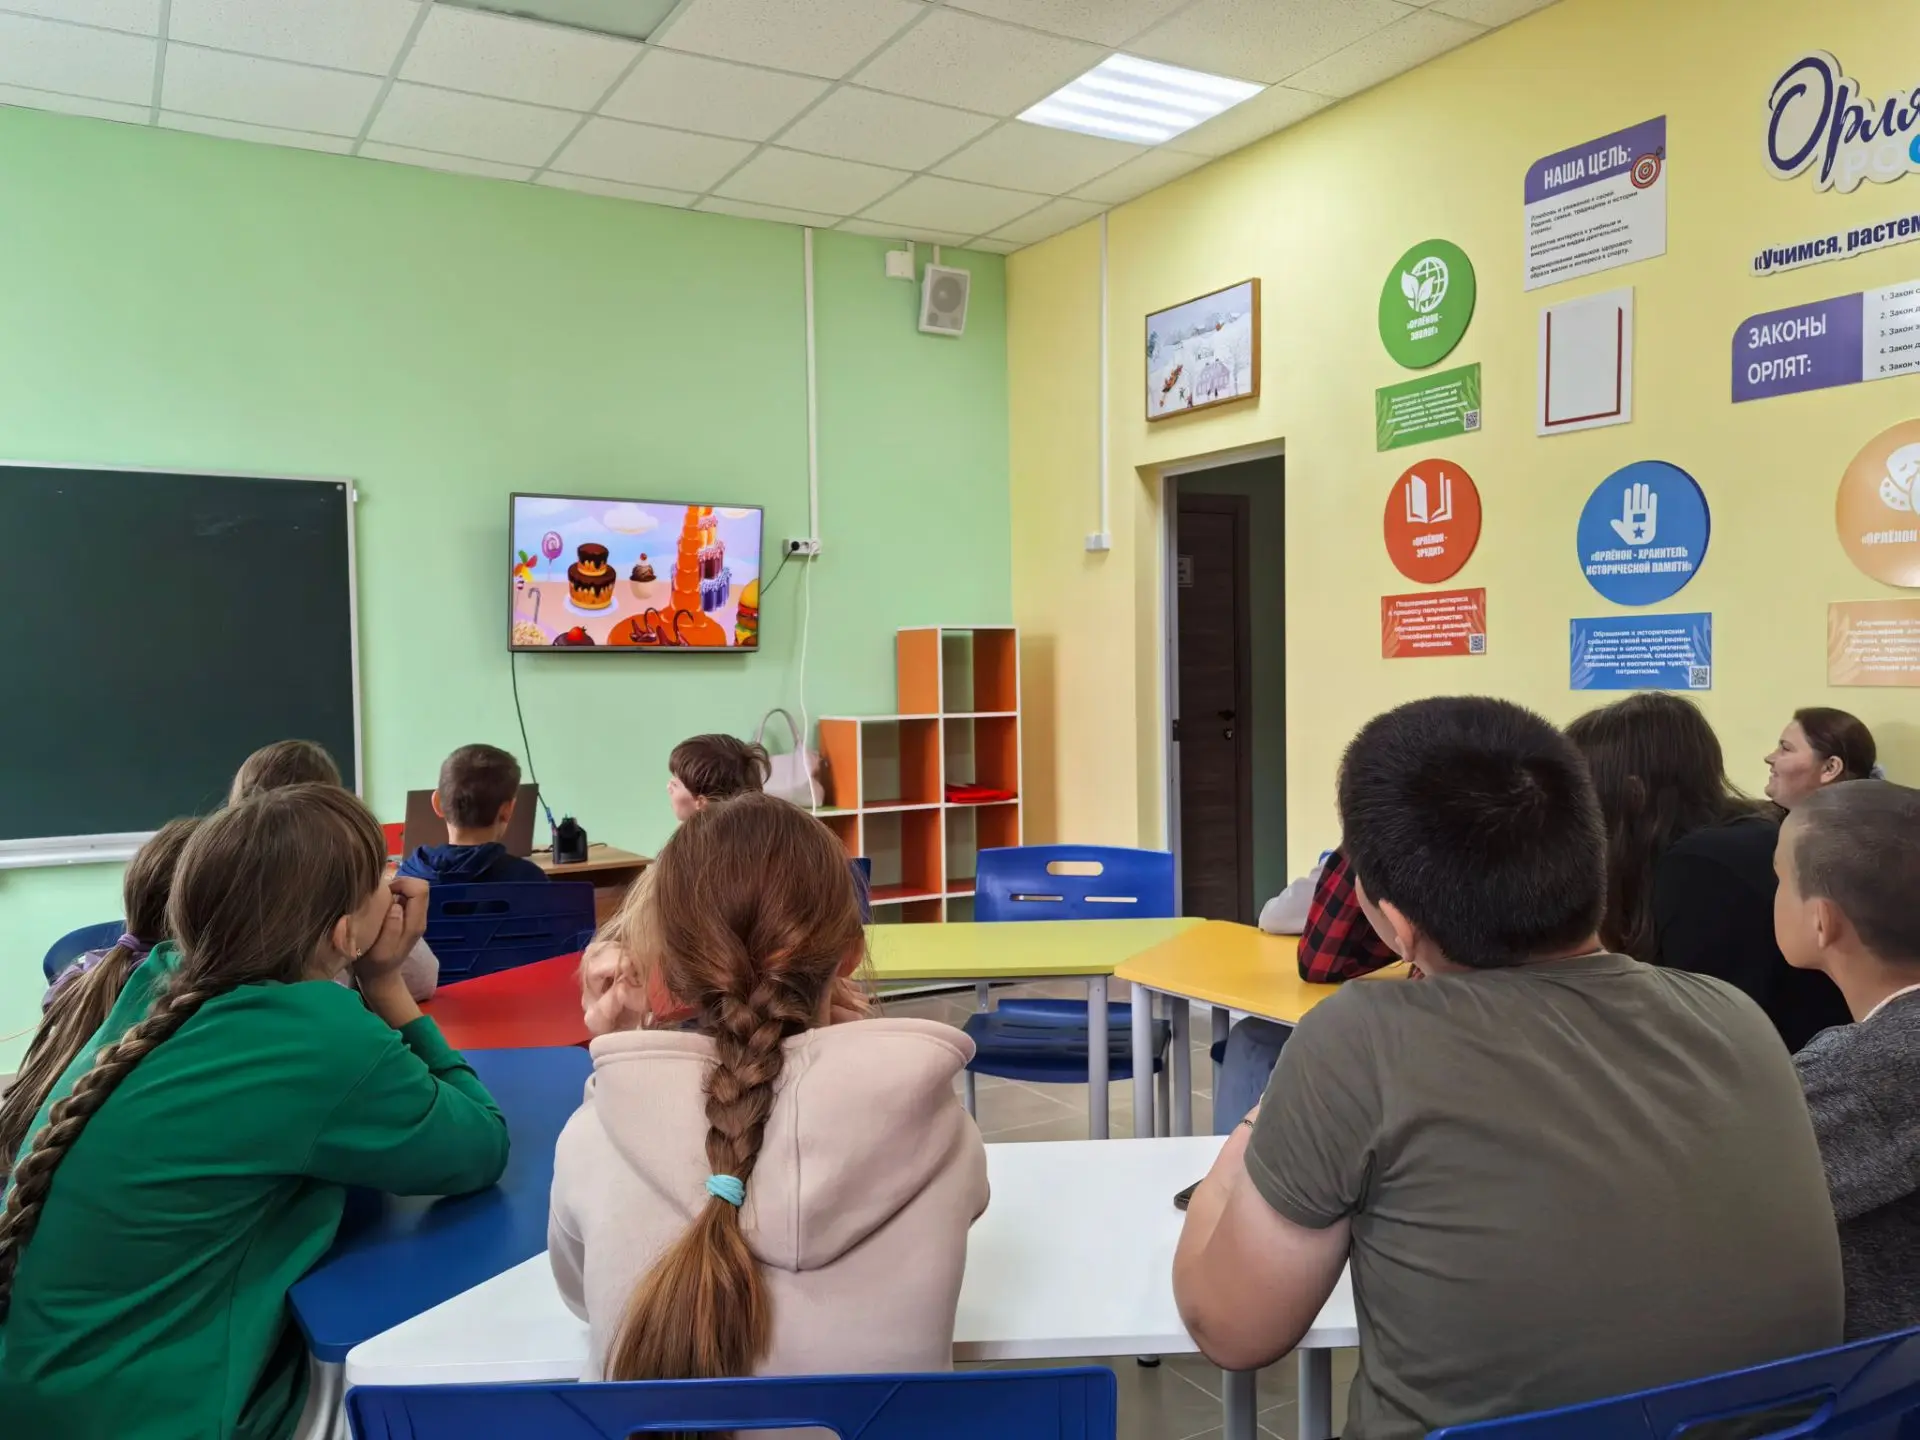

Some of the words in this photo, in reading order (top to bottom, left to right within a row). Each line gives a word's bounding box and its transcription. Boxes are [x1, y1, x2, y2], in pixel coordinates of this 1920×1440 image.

[1544, 158, 1585, 190] НАША
[1588, 145, 1632, 175] ЦЕЛЬ:
[1754, 236, 1842, 271] «Учимся,
[1889, 289, 1914, 300] Закон
[1889, 307, 1914, 317] Закон
[1748, 313, 1826, 349] ЗАКОНЫ
[1889, 324, 1914, 336] Закон
[1888, 343, 1913, 353] Закон
[1747, 353, 1811, 384] ОРЛЯТ:
[1888, 360, 1913, 371] Закон
[1590, 548, 1632, 562] «ОРЛЁНОК
[1638, 546, 1689, 560] ХРАНИТЕЛЬ
[1586, 561, 1651, 576] ИСТОРИЧЕСКОЙ
